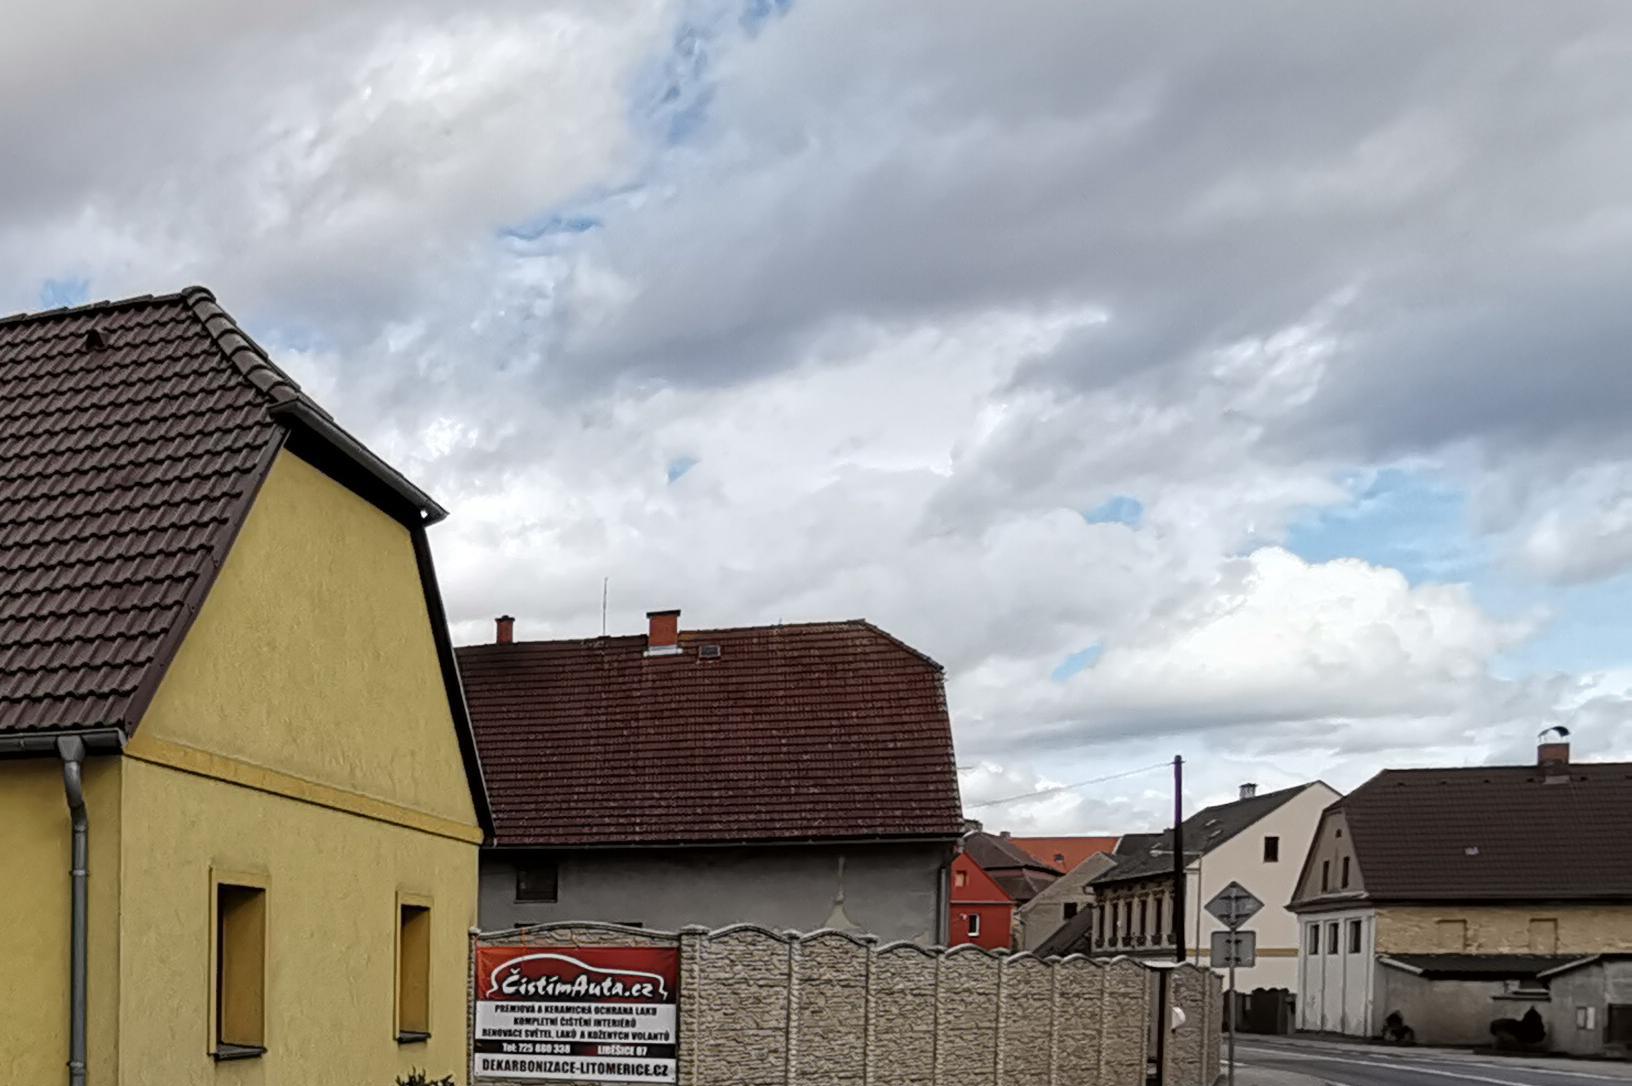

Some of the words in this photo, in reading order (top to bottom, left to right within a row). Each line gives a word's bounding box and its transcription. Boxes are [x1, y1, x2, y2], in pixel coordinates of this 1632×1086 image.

[502, 968, 653, 998] ČistímAuta.cz
[544, 1005, 592, 1015] KERAMICKÁ
[594, 1006, 634, 1015] OCHRANA
[513, 1016, 558, 1026] KOMPLETNÍ
[560, 1016, 591, 1027] ČIŠTĚNÍ
[593, 1018, 637, 1028] INTERIÉRŮ
[482, 1028, 522, 1038] RENOVACE
[555, 1028, 577, 1039] LAKŮ
[579, 1031, 585, 1039] A
[587, 1030, 629, 1040] KOŽENÝCH
[631, 1030, 670, 1042] VOLANTŮ
[482, 1058, 668, 1076] DEKARBONIZACE-LITOMERICE.CZ
